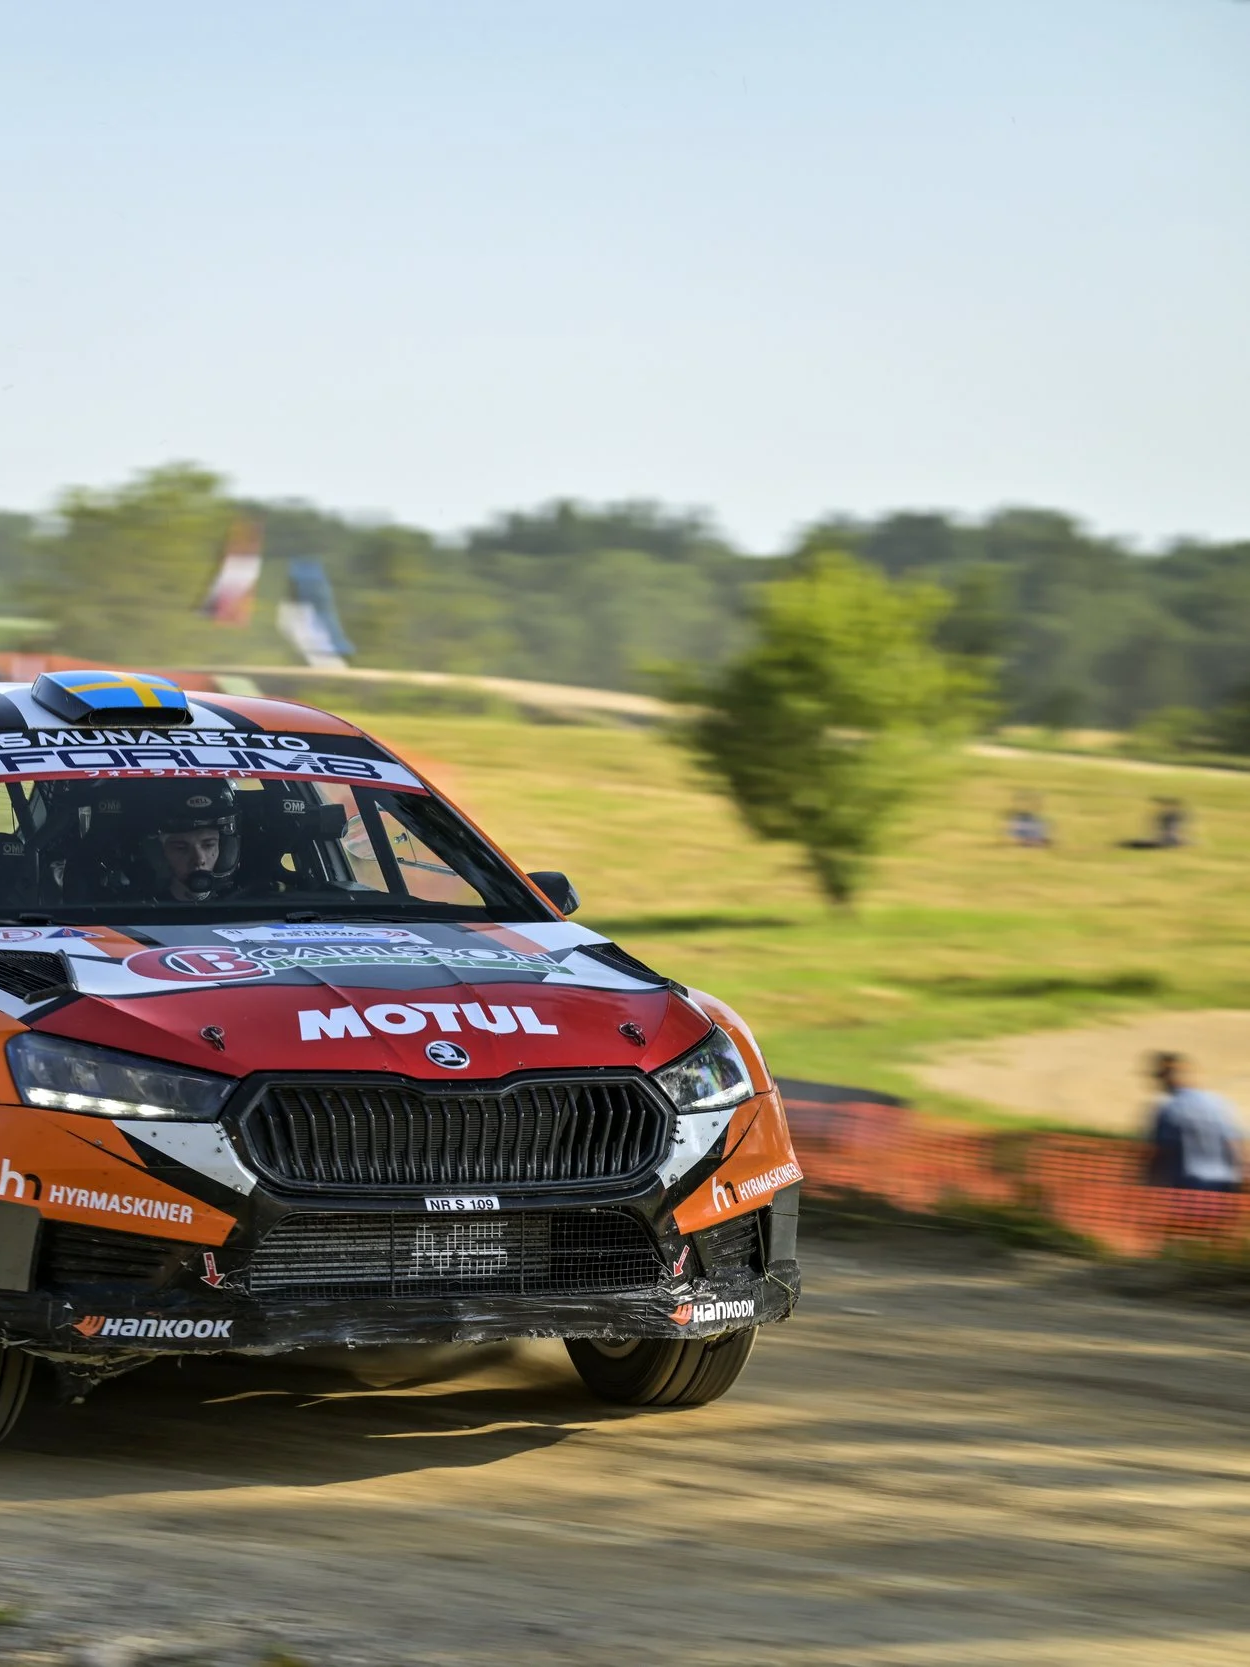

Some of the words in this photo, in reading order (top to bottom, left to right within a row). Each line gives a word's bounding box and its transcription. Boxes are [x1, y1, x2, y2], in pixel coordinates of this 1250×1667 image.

[37, 729, 311, 751] MUNARETTO
[283, 801, 306, 812] OMP
[246, 945, 561, 966] CARLSSON
[297, 1002, 559, 1042] MOTUL
[738, 1162, 802, 1201] HYRMASKINER
[48, 1185, 193, 1225] HYRMASKINER
[430, 1199, 451, 1211] NR
[455, 1199, 466, 1210] S
